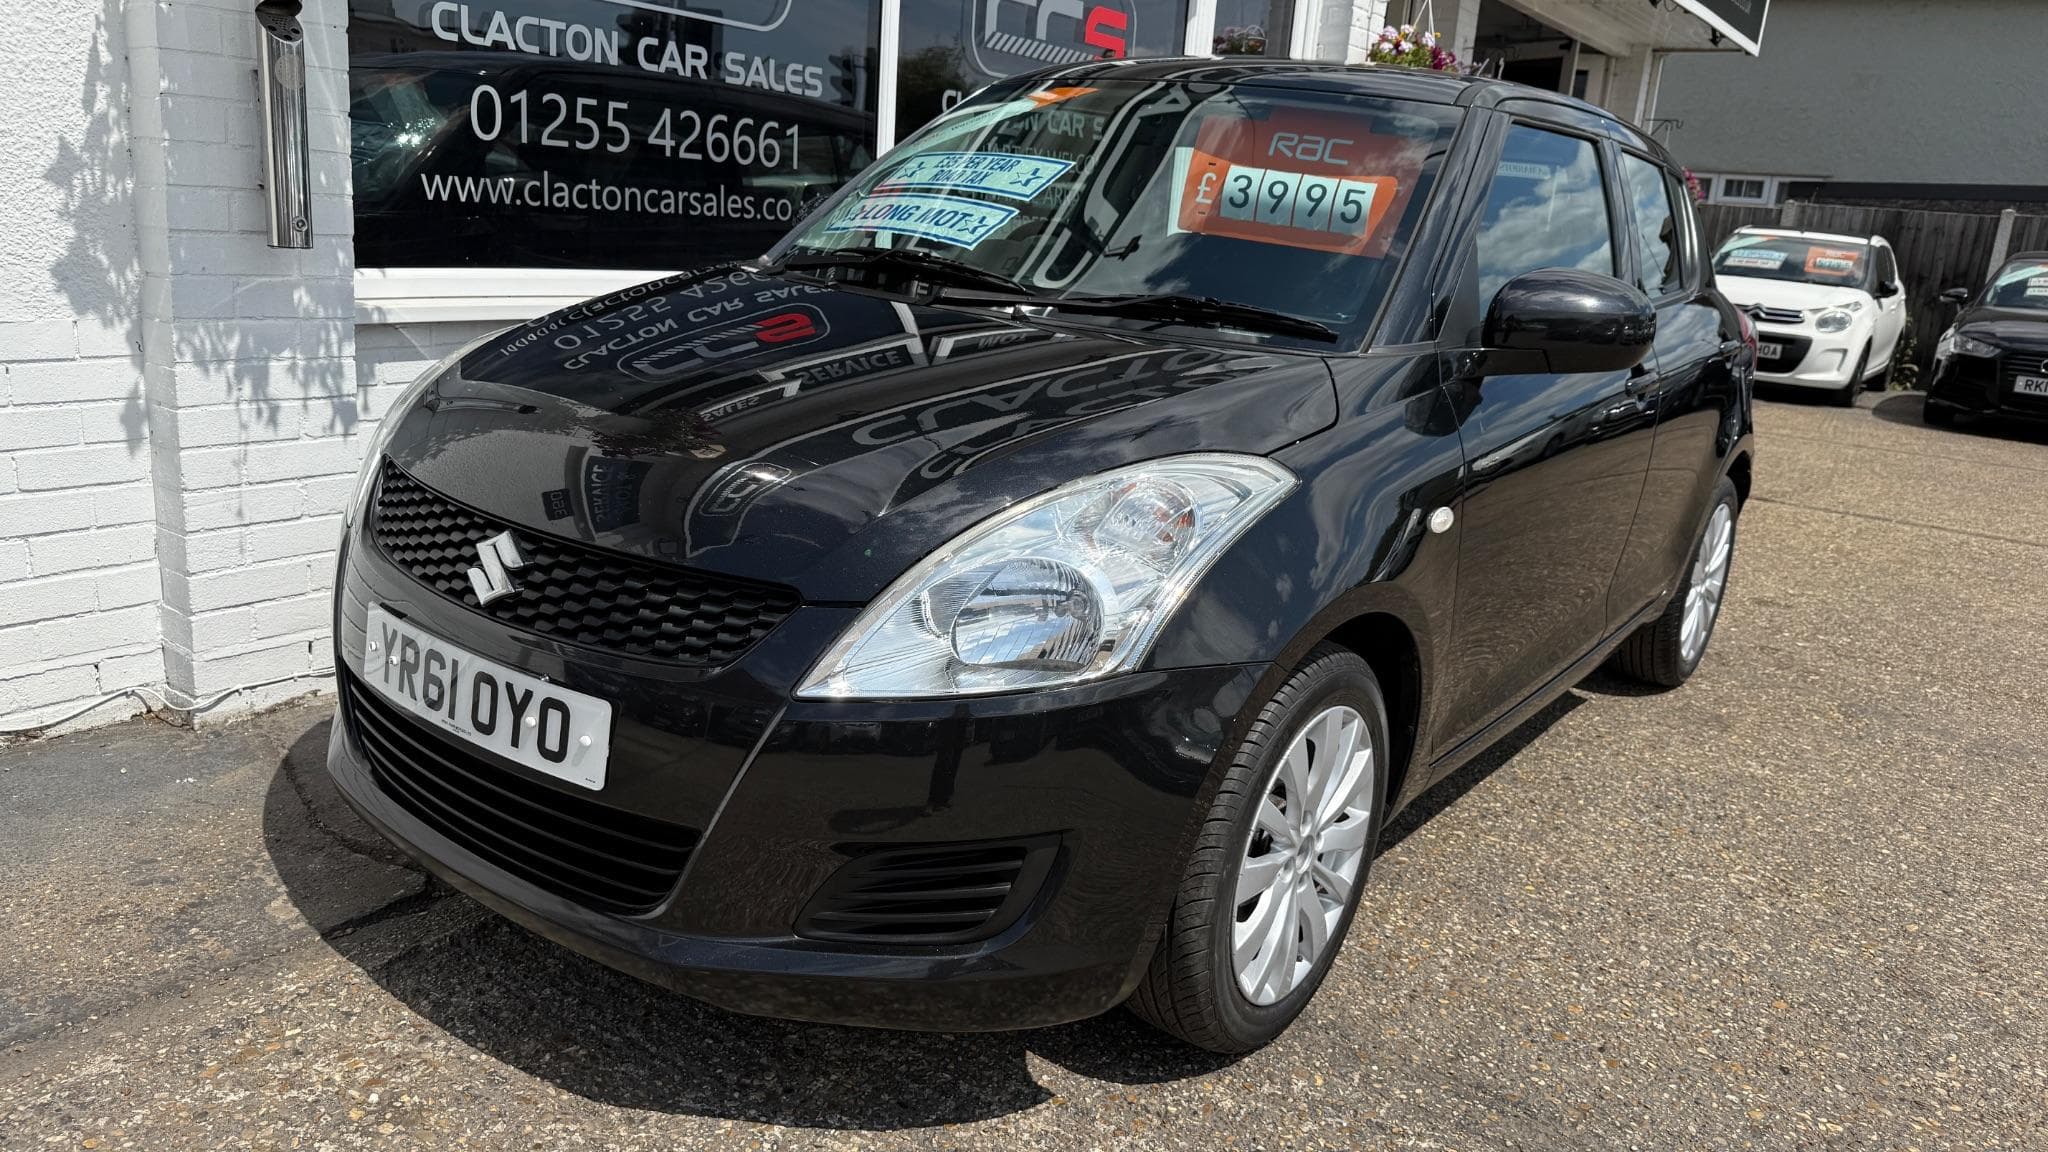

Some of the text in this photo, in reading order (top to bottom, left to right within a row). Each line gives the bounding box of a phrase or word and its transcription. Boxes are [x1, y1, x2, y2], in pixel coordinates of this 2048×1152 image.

[430, 1, 823, 97] CLACTON CAR SALES
[470, 84, 801, 171] 01255 426661
[961, 170, 993, 185] TAX
[982, 157, 1021, 172] YEAR
[421, 171, 793, 222] www.clactoncarsales.co
[860, 204, 974, 229] LONG MOT
[382, 621, 571, 764] YR61 OYO
